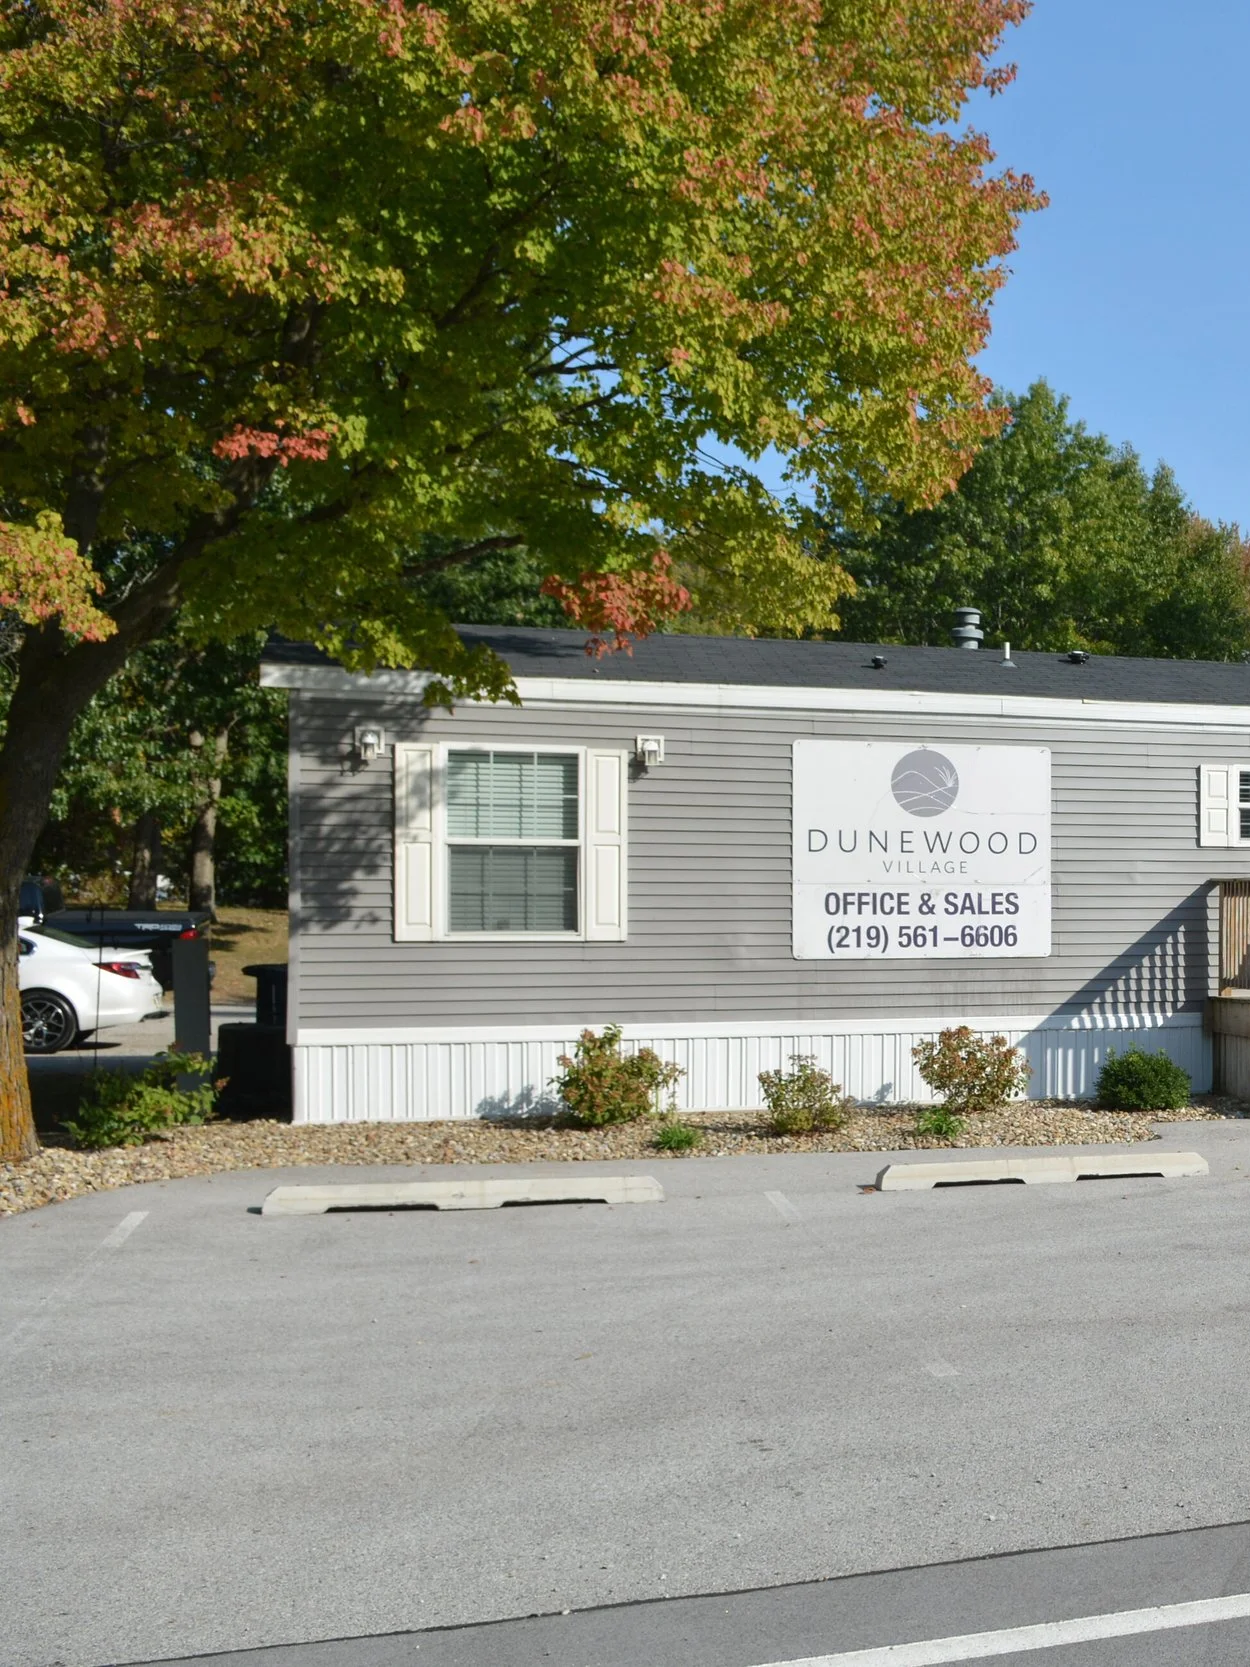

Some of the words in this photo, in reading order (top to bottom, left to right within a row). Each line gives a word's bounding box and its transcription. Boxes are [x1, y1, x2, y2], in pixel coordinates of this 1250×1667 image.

[807, 829, 1038, 855] DUNEWOOD
[882, 860, 969, 874] VILLAGE
[824, 892, 910, 916] OFFICE
[917, 892, 936, 916] &
[943, 892, 1020, 916] SALES
[827, 925, 890, 953] (219)
[897, 924, 1018, 948] 561-6606
